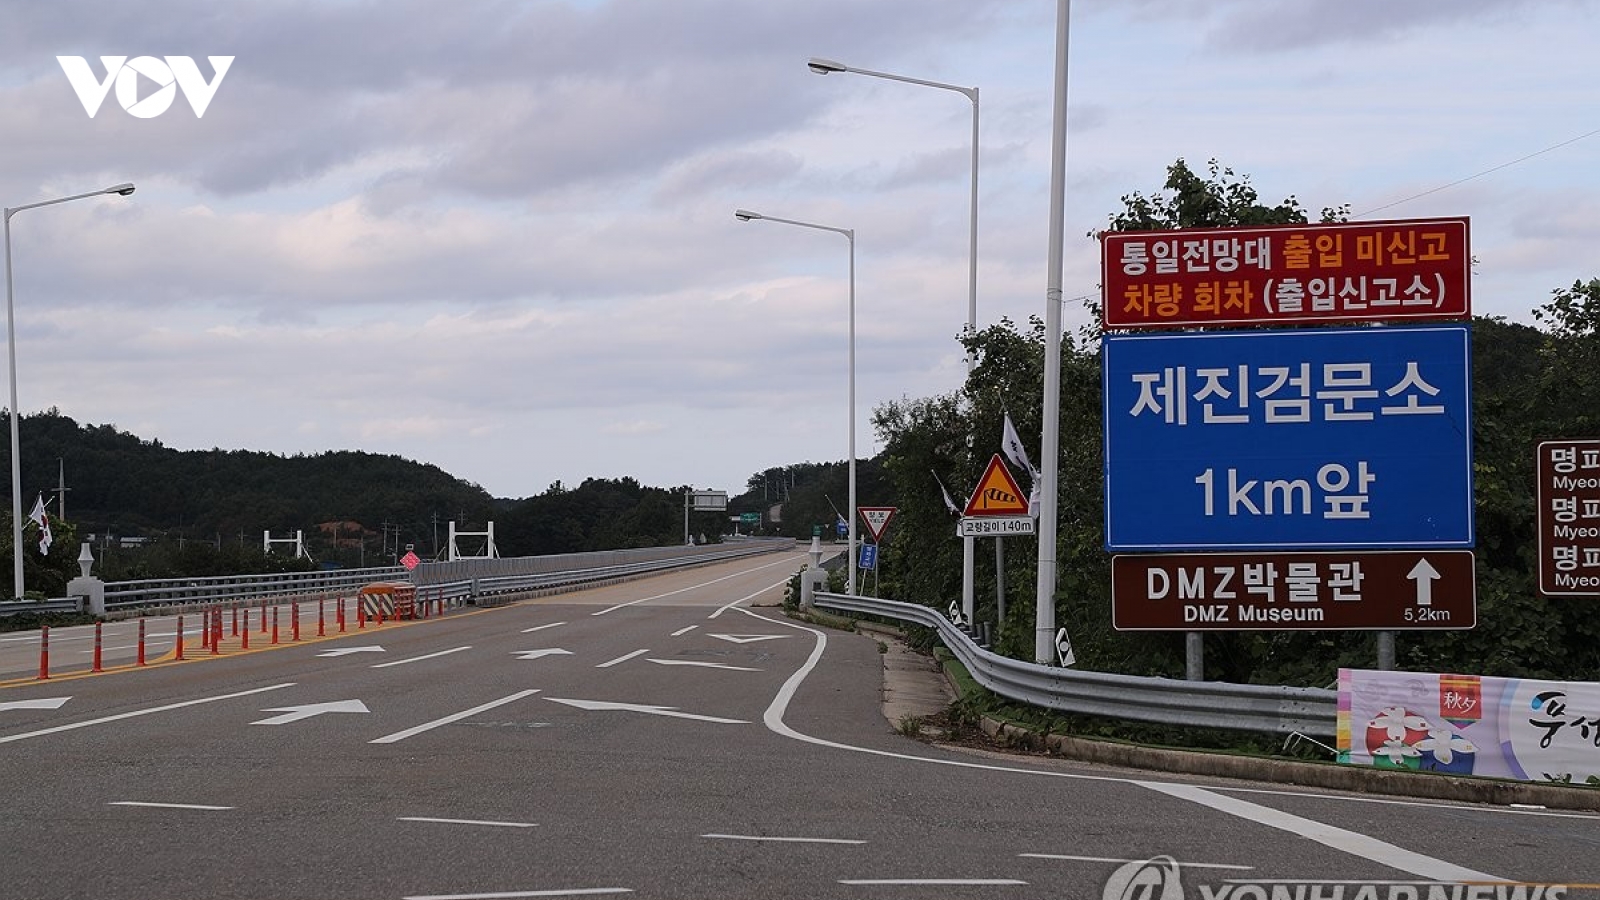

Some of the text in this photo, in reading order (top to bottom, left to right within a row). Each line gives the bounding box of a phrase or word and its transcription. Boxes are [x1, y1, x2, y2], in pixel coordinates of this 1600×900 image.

[1120, 230, 1450, 275] 통일전망대 출입 미신고
[1123, 272, 1446, 317] 차량 회차 (출입신고소)
[1129, 361, 1446, 425] 제진검문소
[1194, 460, 1376, 520] 1km앞
[1002, 520, 1032, 532] 140m
[1553, 524, 1600, 541] Myeo
[1183, 604, 1325, 622] DMZ Museum
[1443, 691, 1477, 713] 秋夕
